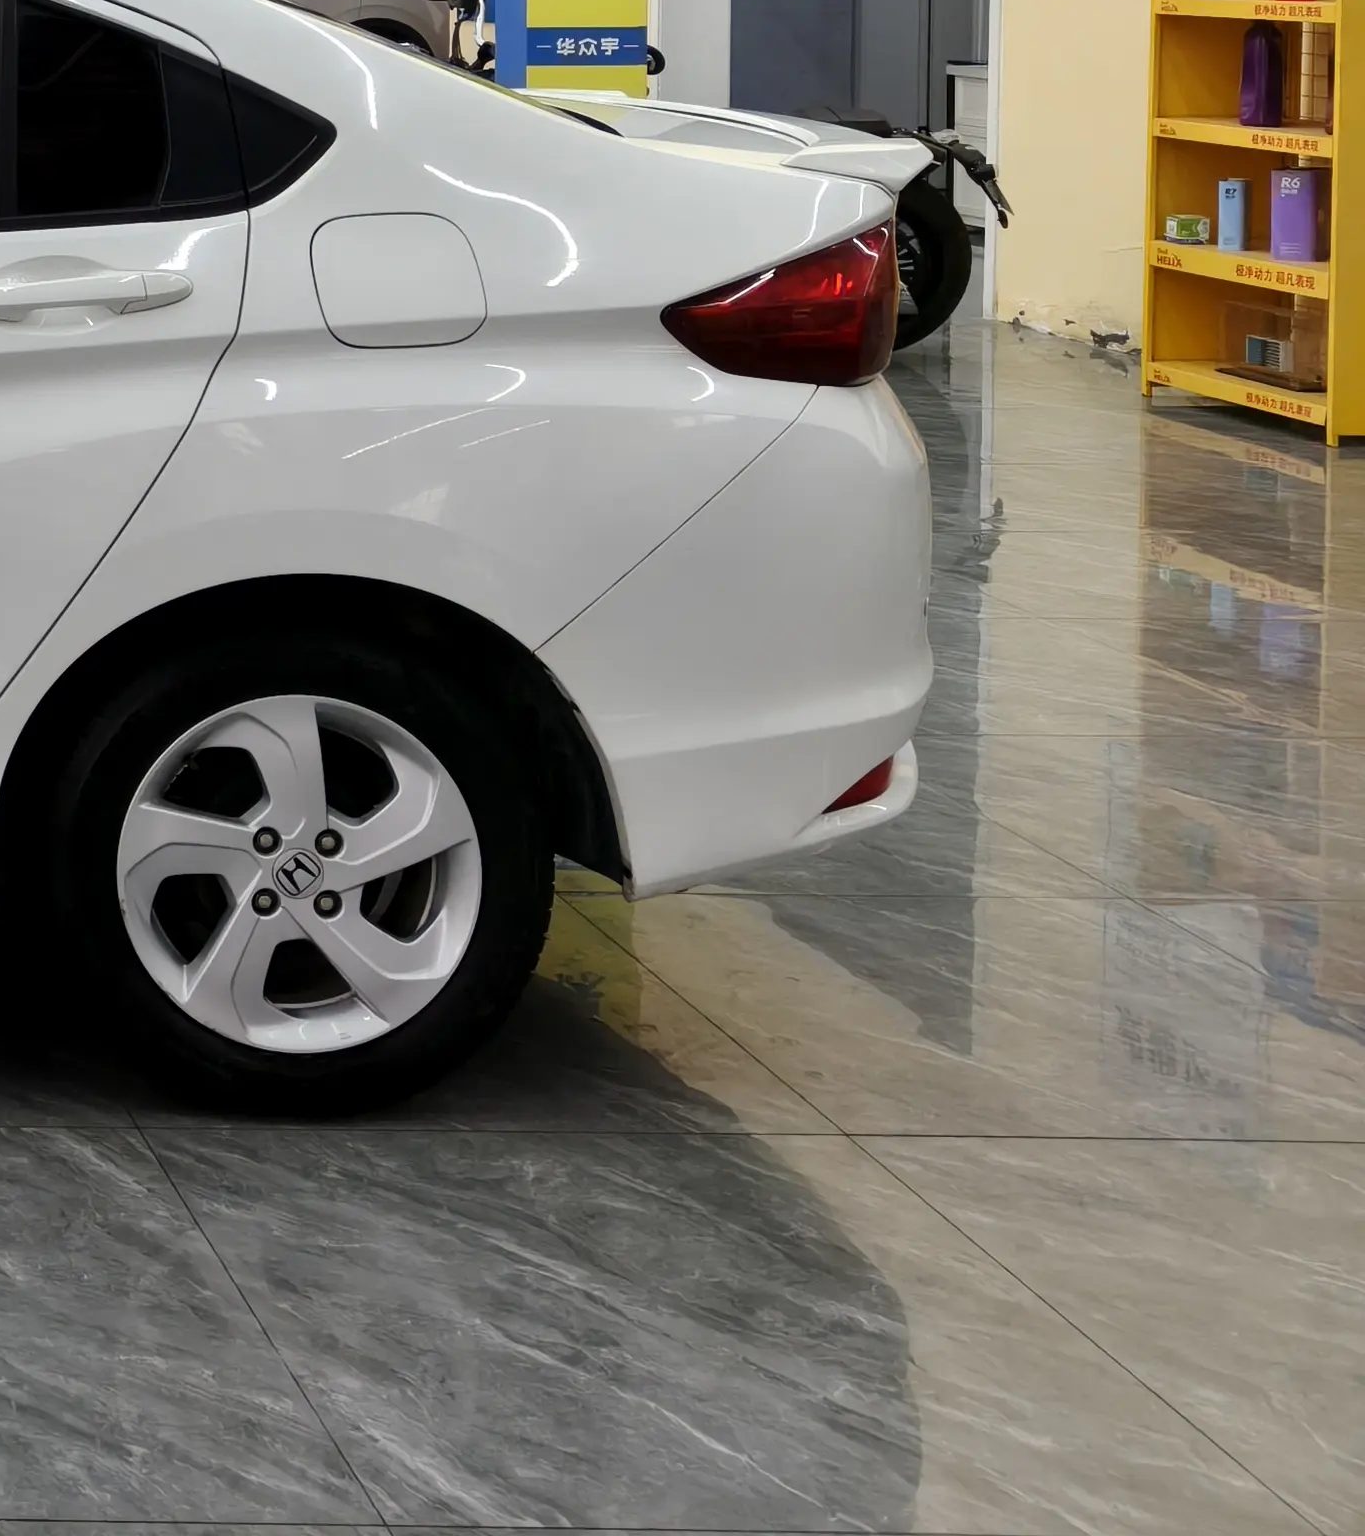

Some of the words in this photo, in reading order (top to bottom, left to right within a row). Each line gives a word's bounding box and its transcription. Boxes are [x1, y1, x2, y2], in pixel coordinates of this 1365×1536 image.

[556, 37, 620, 56] 华众宇
[1280, 177, 1301, 188] R6
[1157, 254, 1182, 268] HELIX
[1235, 265, 1273, 282] 极净动力
[1276, 271, 1316, 290] 超凡表现
